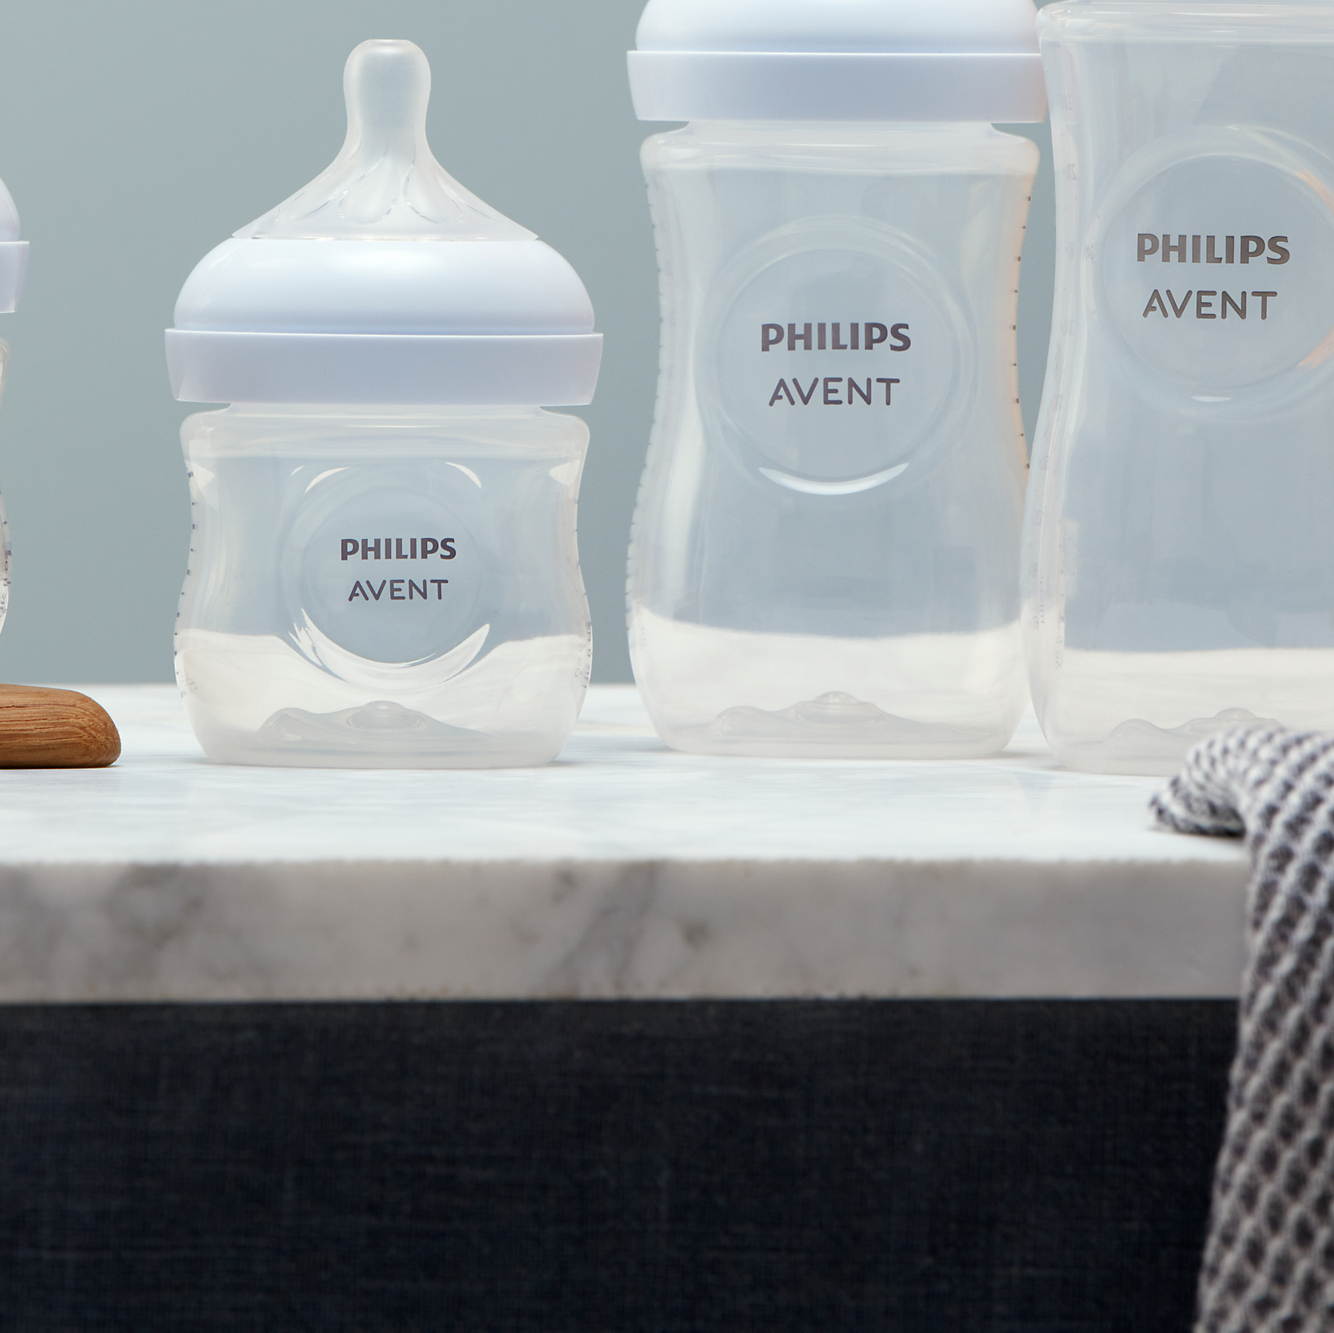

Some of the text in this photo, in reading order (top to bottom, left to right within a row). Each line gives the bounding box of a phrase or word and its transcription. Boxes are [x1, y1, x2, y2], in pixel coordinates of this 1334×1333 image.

[1137, 232, 1290, 266] PHILIPS
[1143, 288, 1278, 321] AVENT
[761, 321, 912, 353] PHILIPS
[769, 376, 901, 408] AVENT
[340, 536, 457, 562] PHILIPS
[348, 578, 449, 603] AVENT
